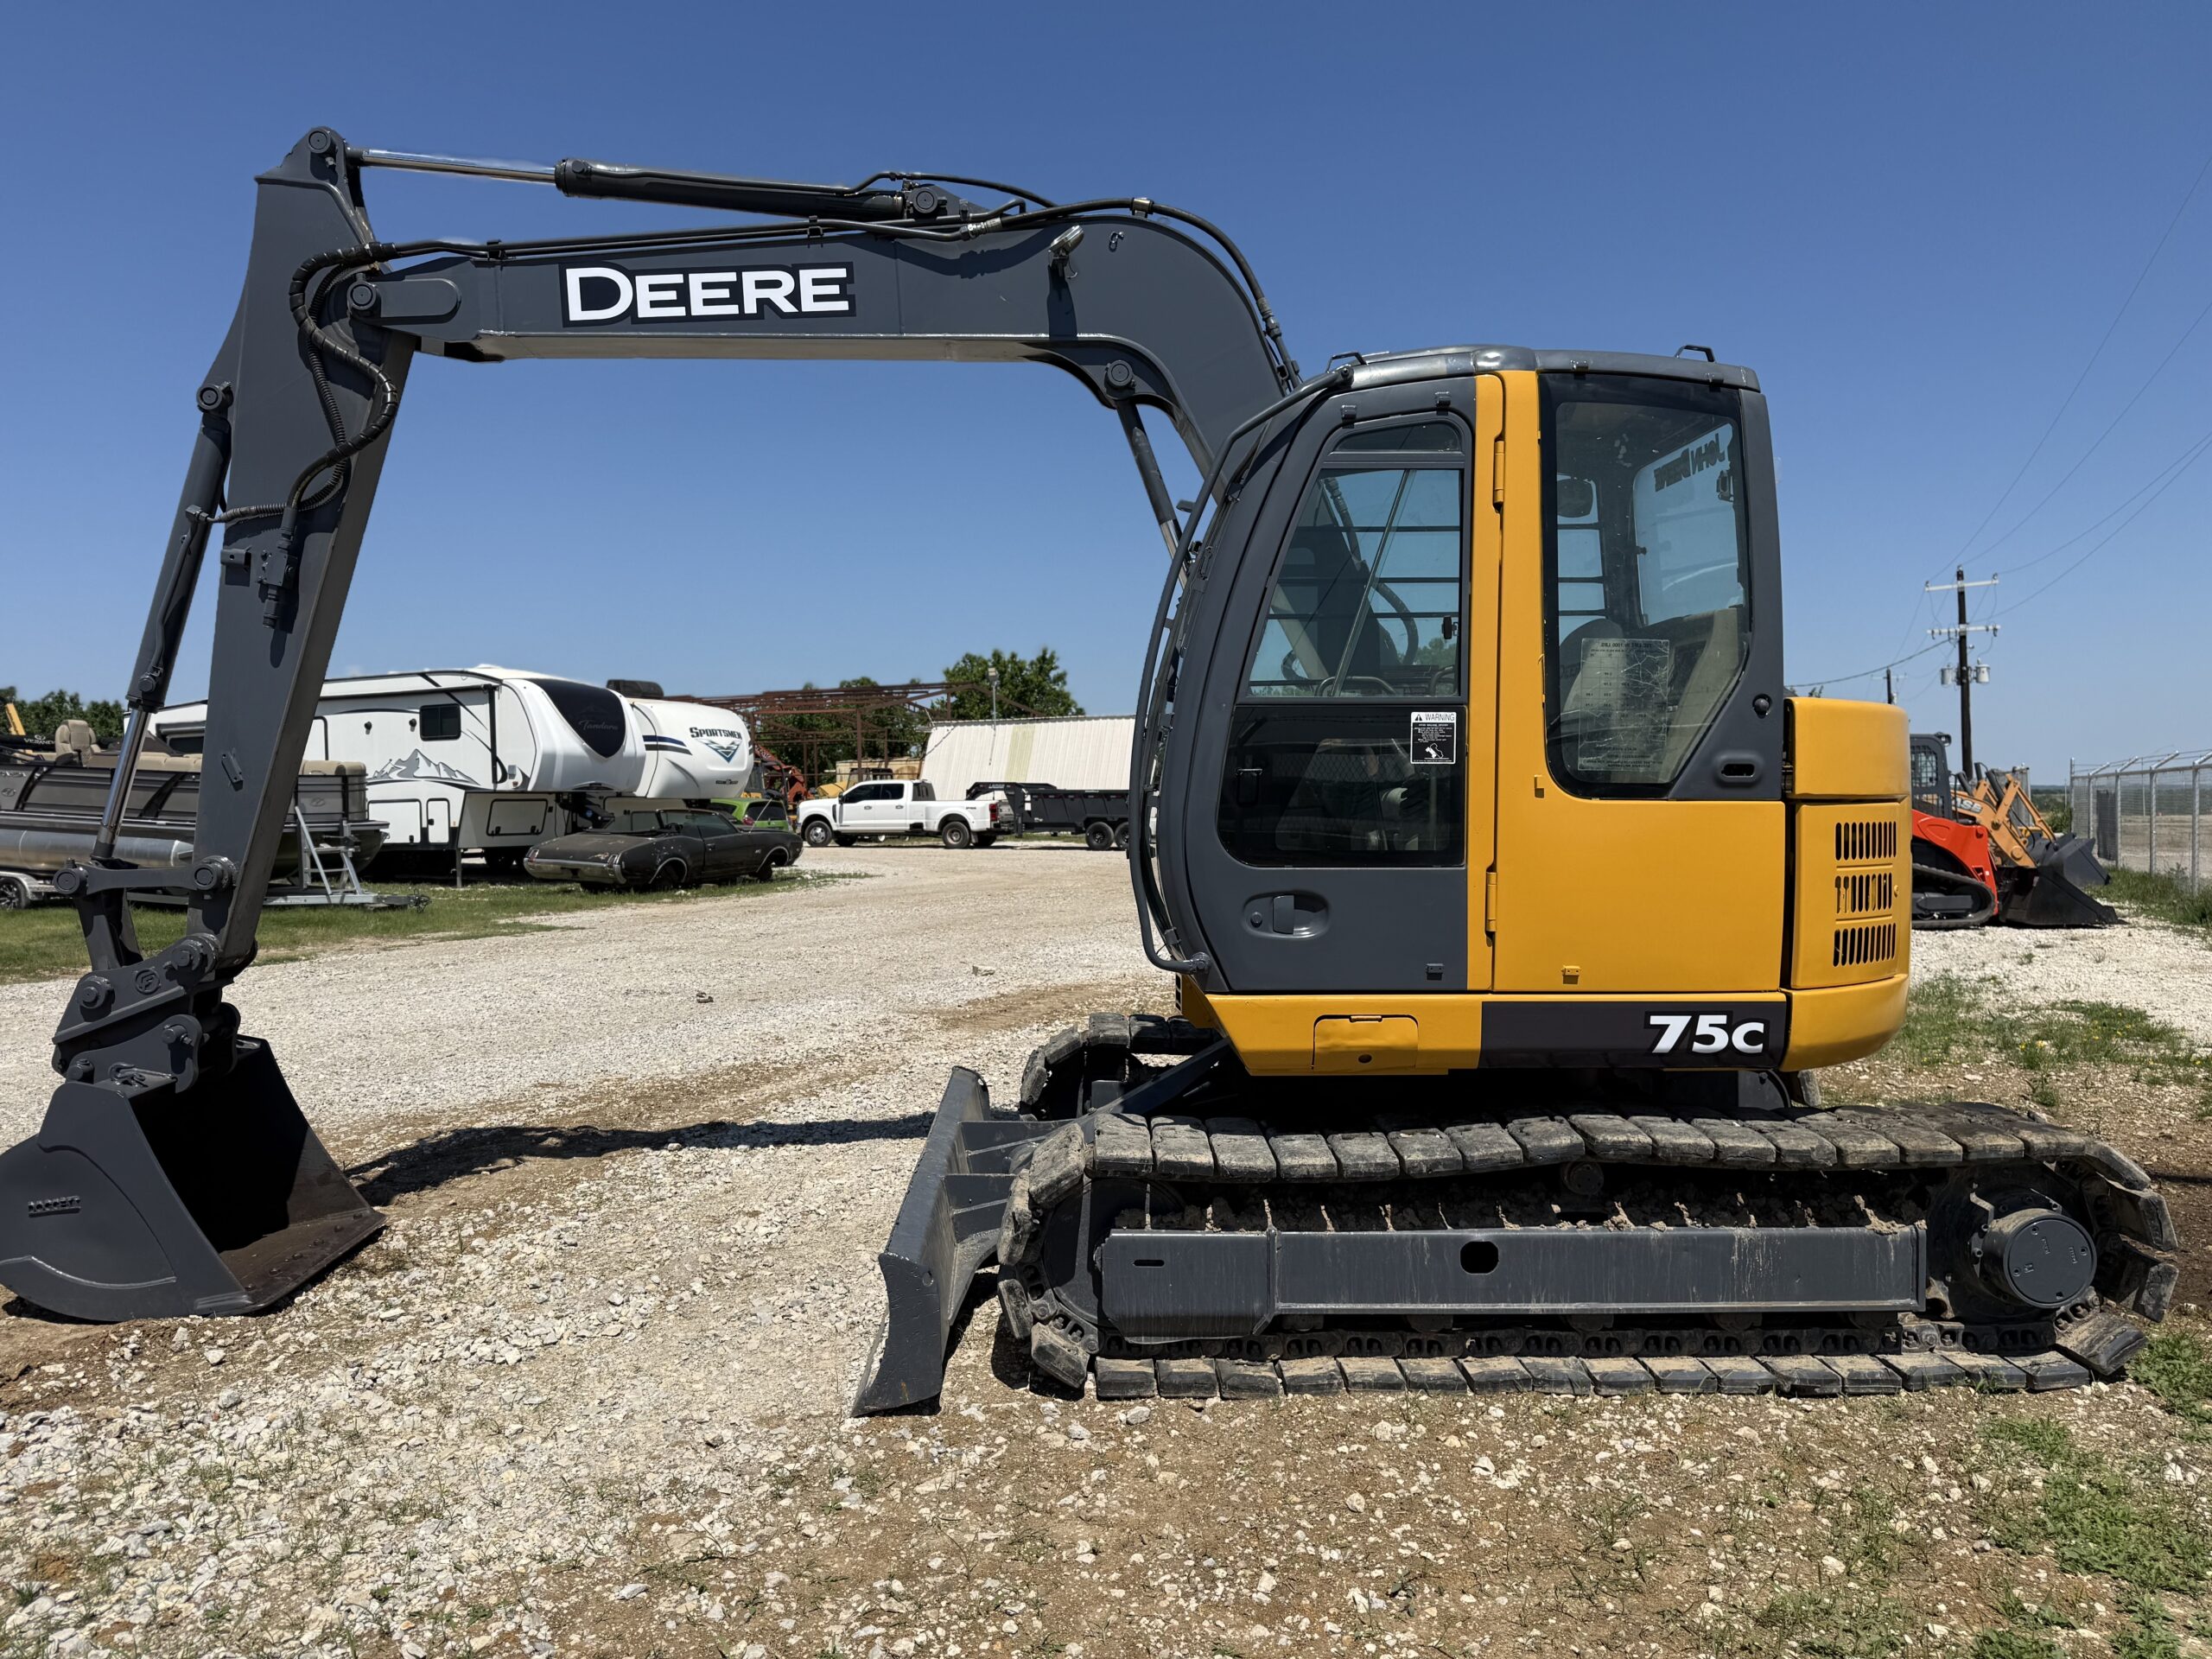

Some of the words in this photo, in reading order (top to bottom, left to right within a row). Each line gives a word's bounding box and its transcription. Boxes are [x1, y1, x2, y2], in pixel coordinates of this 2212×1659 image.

[566, 267, 849, 321] DEERE
[690, 727, 742, 740] SPORTSMEN
[1951, 797, 1982, 812] ASE
